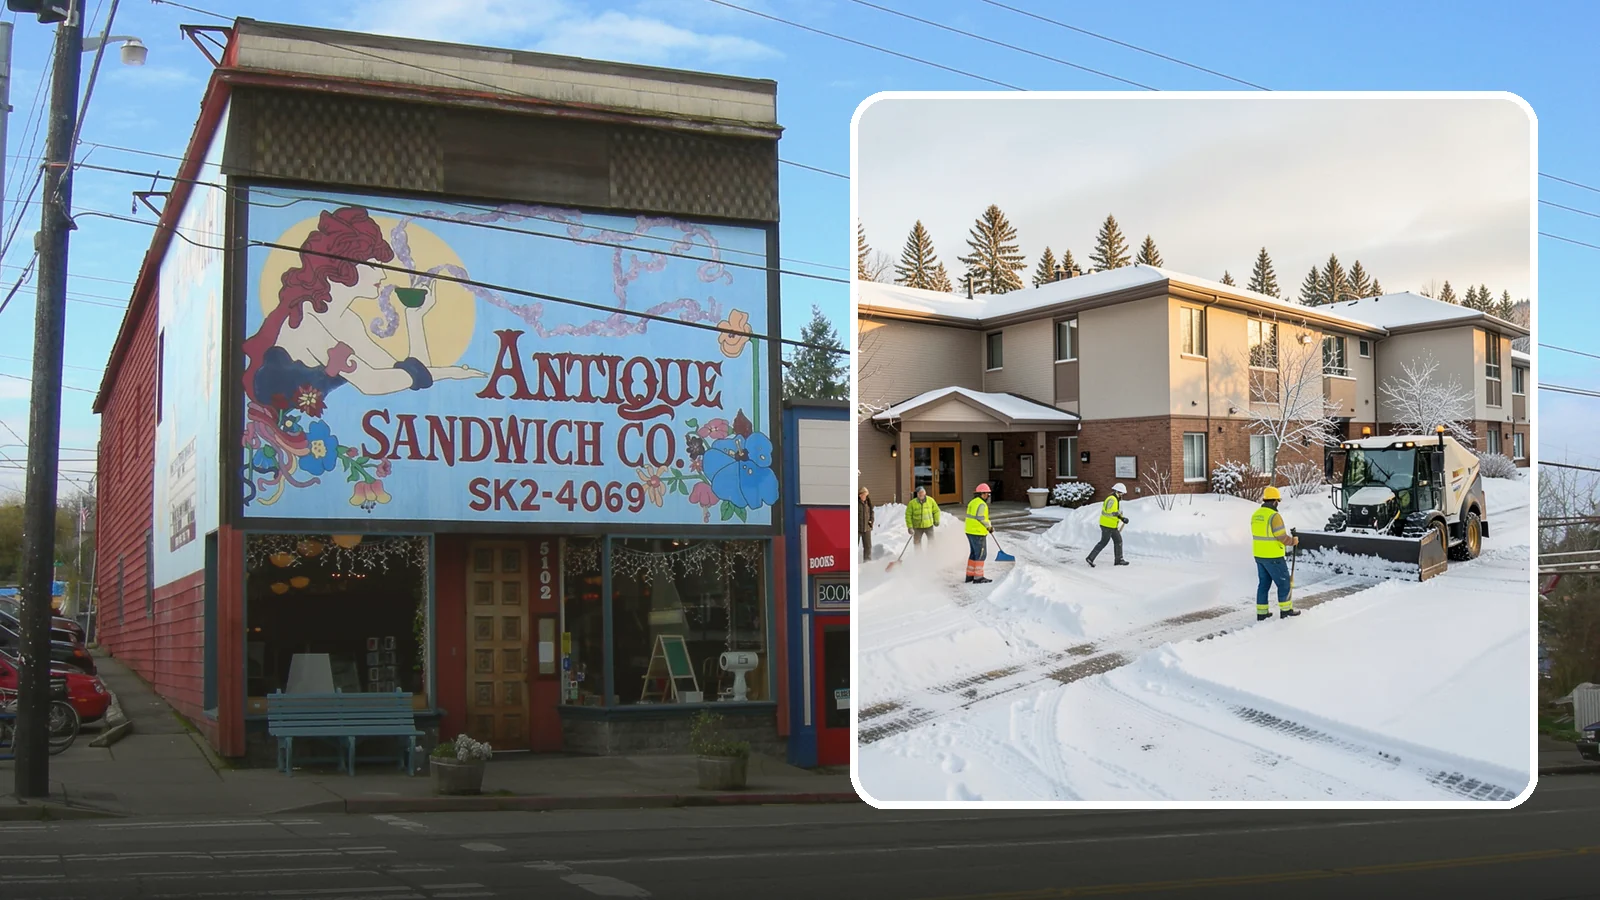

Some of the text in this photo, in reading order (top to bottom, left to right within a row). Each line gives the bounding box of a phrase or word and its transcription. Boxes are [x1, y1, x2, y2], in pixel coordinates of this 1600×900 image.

[476, 328, 724, 420] ANTIQUE
[361, 409, 684, 468] SANDWICH CO.
[468, 477, 646, 513] SK2-4069
[539, 542, 552, 600] 5102
[809, 555, 835, 569] BOOKS
